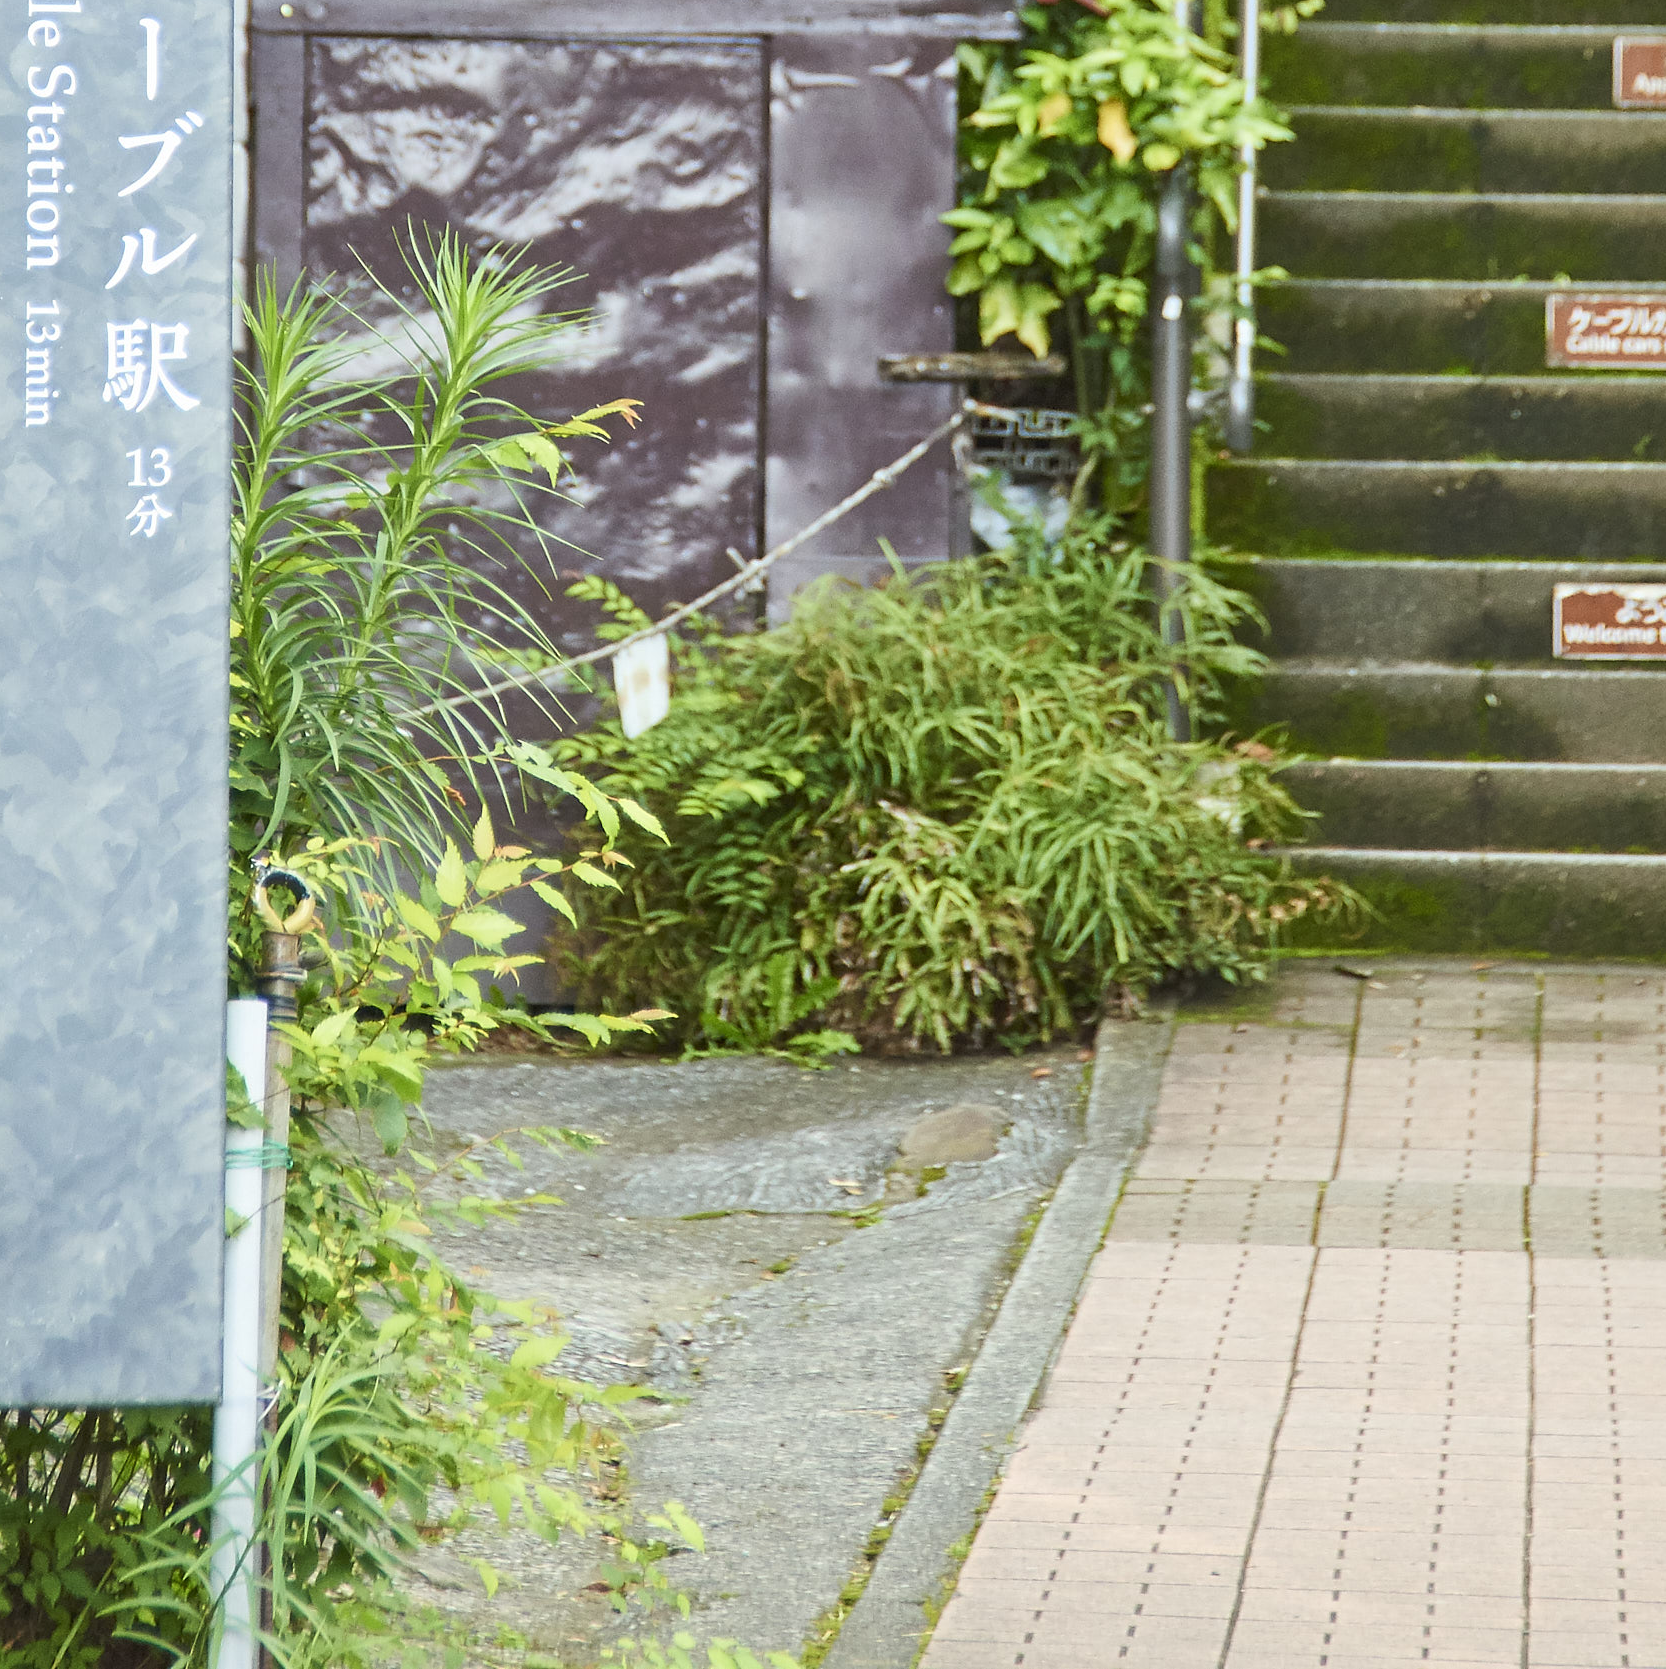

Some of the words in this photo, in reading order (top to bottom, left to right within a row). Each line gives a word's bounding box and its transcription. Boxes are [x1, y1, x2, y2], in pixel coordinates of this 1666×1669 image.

[25, 64, 77, 270] Station
[24, 299, 61, 428] 13min
[125, 446, 172, 539] 13分
[1563, 623, 1658, 645] Welcome
